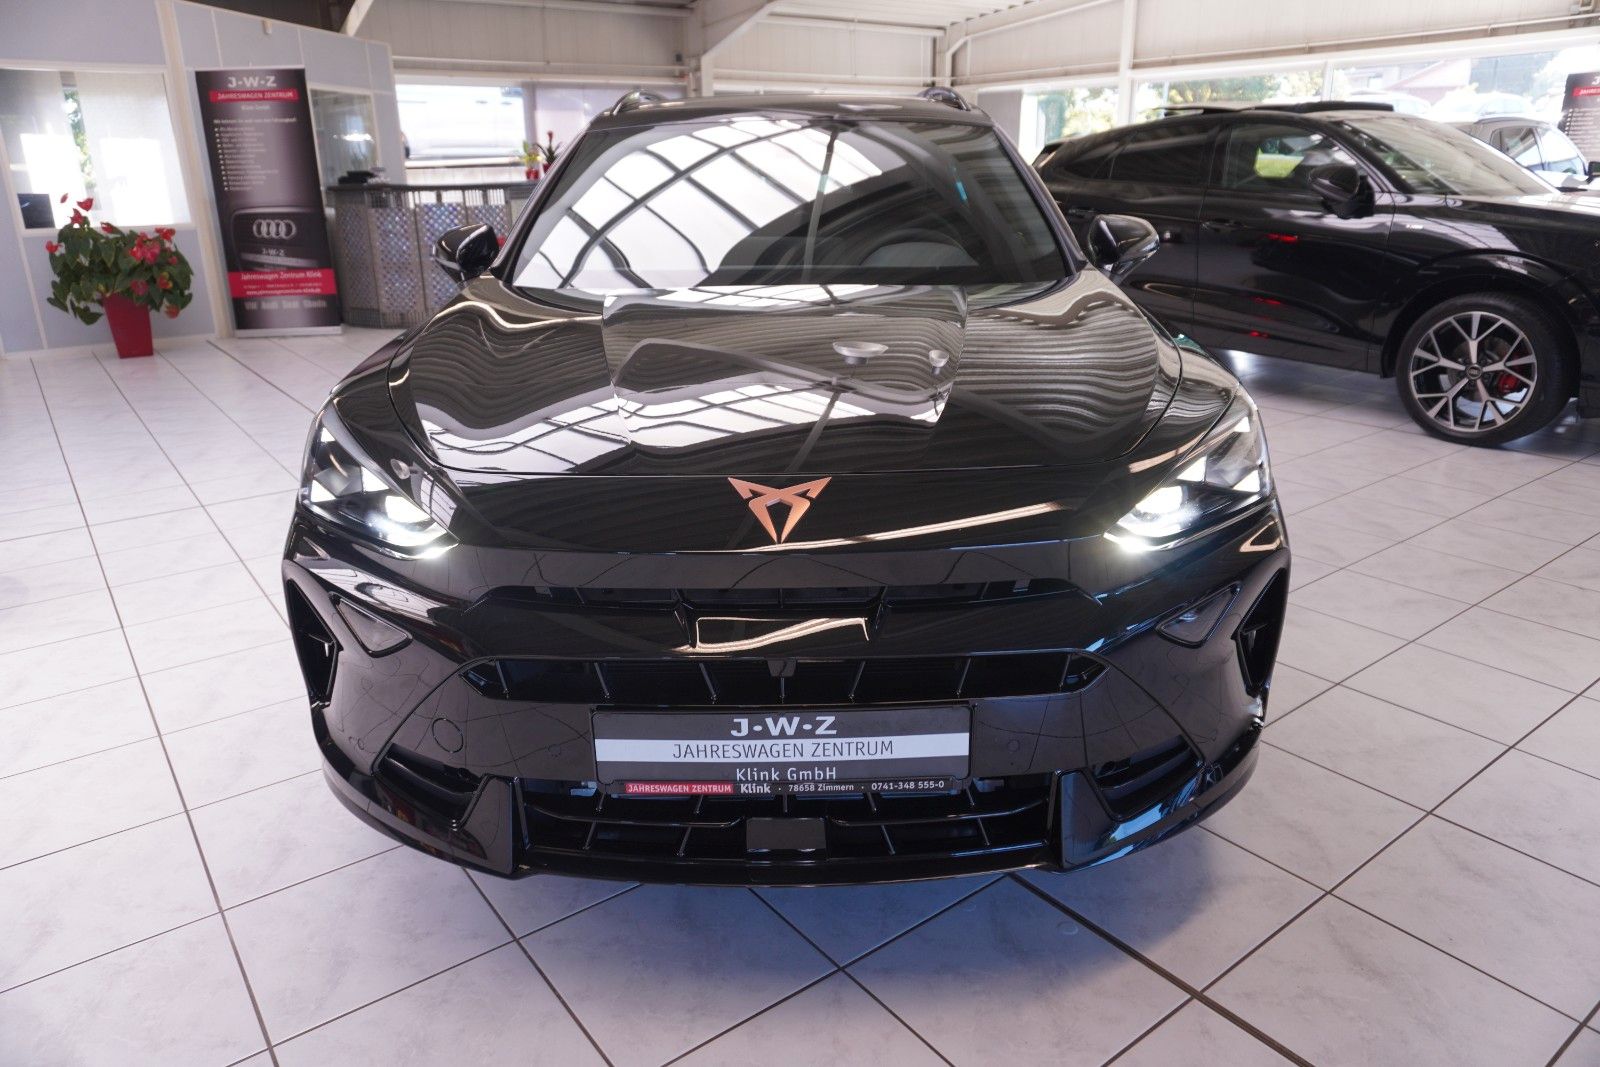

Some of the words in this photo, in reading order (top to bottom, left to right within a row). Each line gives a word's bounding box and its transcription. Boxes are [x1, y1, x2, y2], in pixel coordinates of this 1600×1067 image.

[672, 743, 804, 759] JAHRESWAGEN
[811, 740, 894, 757] ZENTRUM
[736, 767, 780, 781] Klink
[787, 766, 837, 780] GmbH
[628, 783, 689, 793] JAHRESWAGEN
[691, 783, 732, 793] ZENTRUM
[740, 783, 771, 794] Klink
[788, 784, 815, 792] 78658
[817, 782, 855, 792] Zimmern
[870, 781, 915, 791] 0741-348
[918, 780, 945, 790] 555-0
